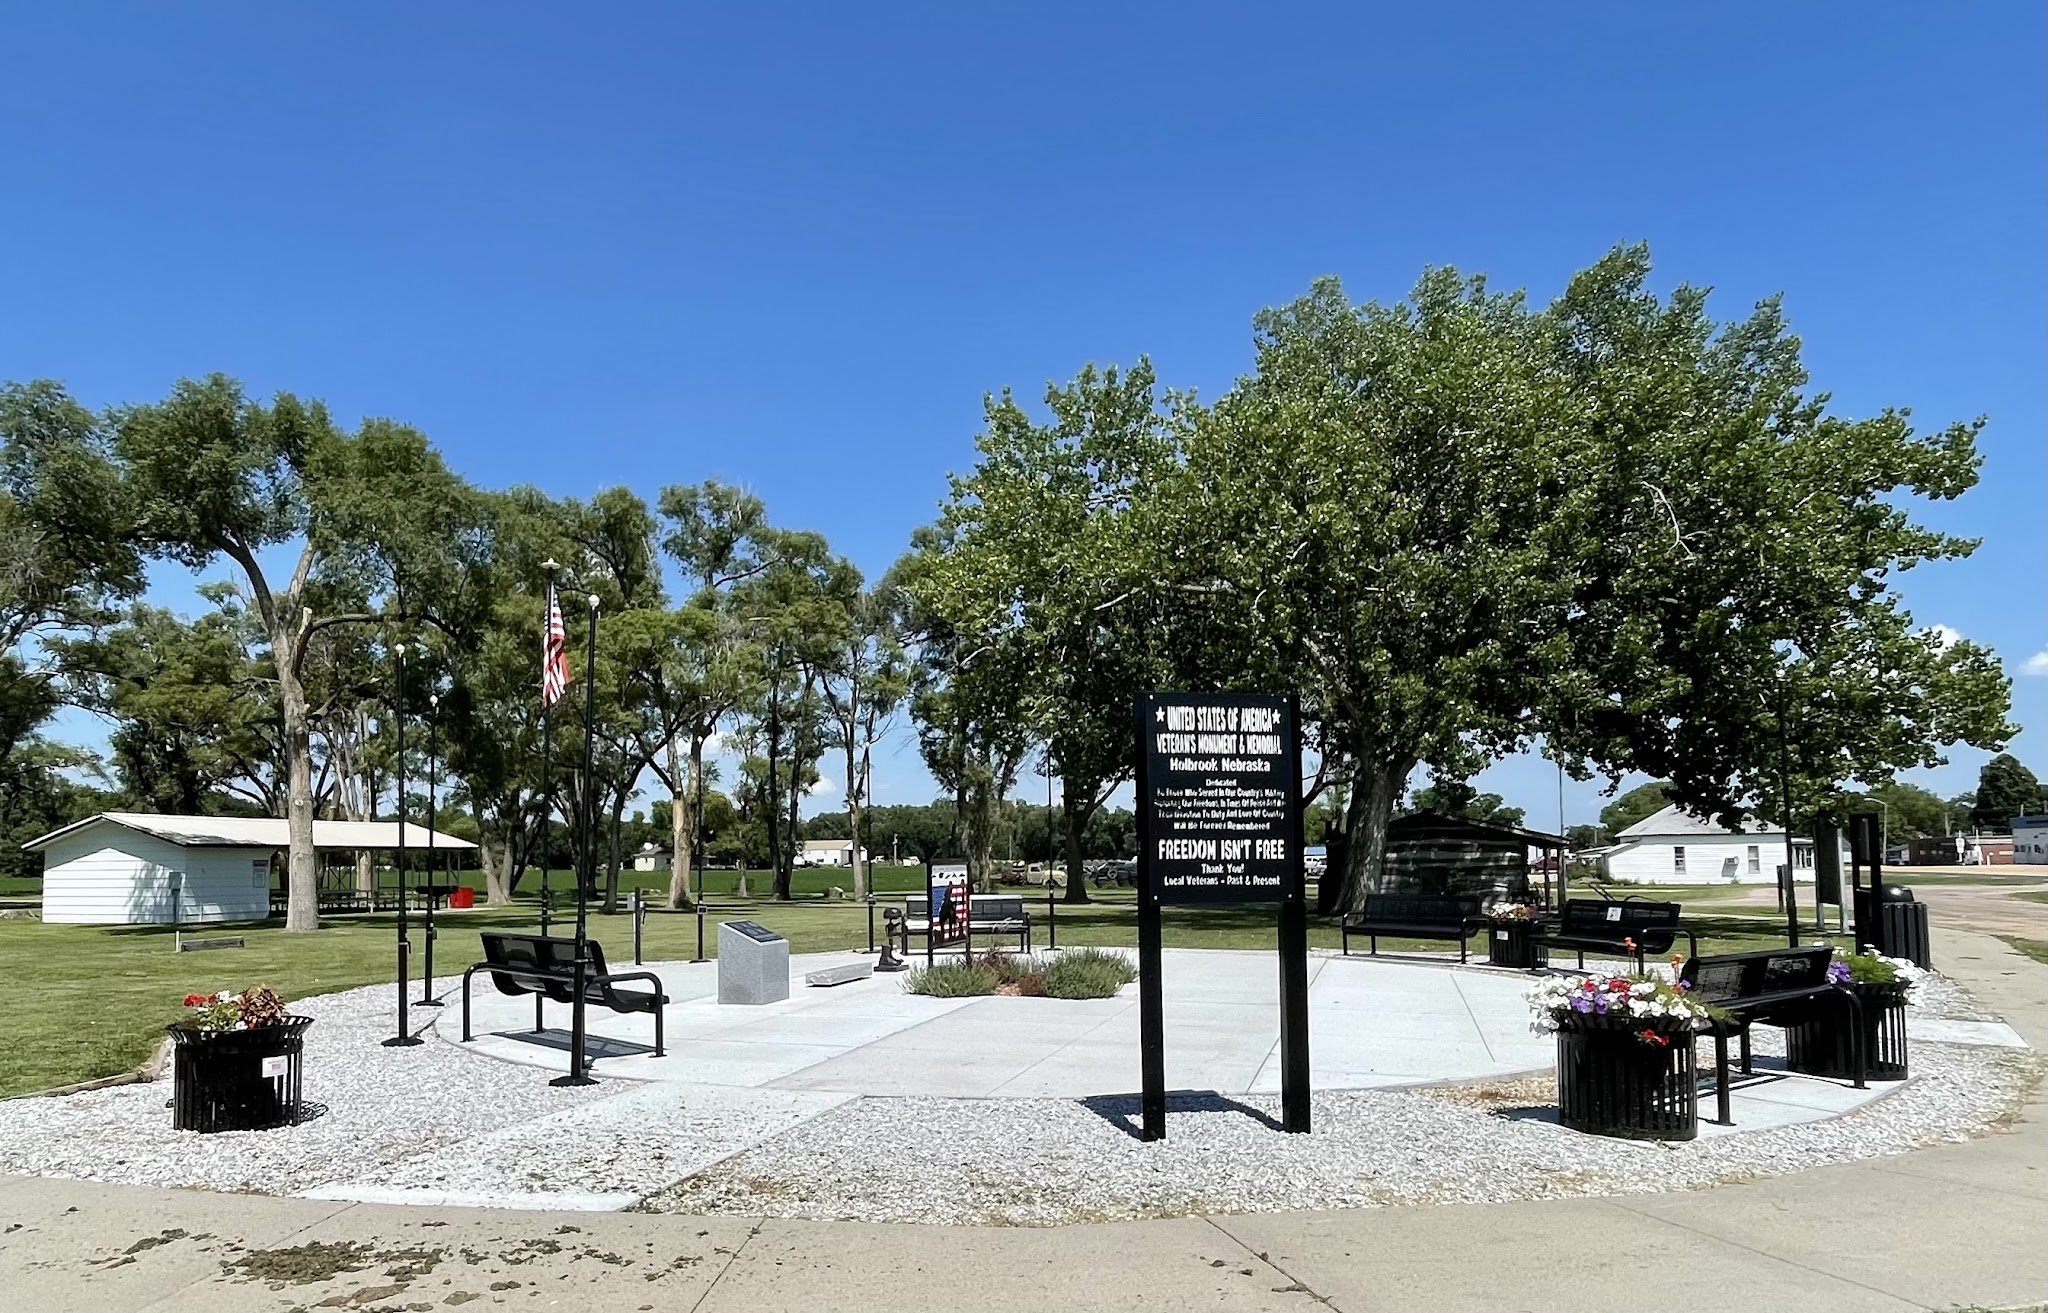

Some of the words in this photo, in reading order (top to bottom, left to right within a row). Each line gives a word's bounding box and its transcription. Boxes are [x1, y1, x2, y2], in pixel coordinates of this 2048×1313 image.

[1167, 706, 1195, 731] UNITED
[1197, 706, 1226, 731] STATES
[1227, 707, 1239, 731] OF
[1240, 708, 1273, 732] AMERICA
[1198, 734, 1237, 754] MONUMENT
[1239, 735, 1245, 754] &
[1247, 735, 1282, 755] MEMORIAL
[1169, 758, 1218, 771] Holbrook
[1221, 758, 1271, 772] Nebraska
[1205, 778, 1237, 786] Dedicated
[1184, 788, 1198, 796] Who
[1198, 787, 1218, 797] Served
[1225, 787, 1236, 797] Our
[1210, 809, 1225, 820] Duty
[1226, 809, 1238, 818] And
[1238, 809, 1252, 818] Love
[1253, 809, 1261, 818] Of
[1226, 821, 1271, 831] Remembered
[1158, 839, 1216, 860] FREEDOM
[1220, 839, 1251, 860] ISN'T
[1255, 839, 1285, 860] FREE
[1201, 863, 1224, 874] Thank
[1226, 863, 1244, 874] You!
[1164, 875, 1184, 886] Local
[1186, 875, 1219, 885] Veterans
[1226, 875, 1243, 886] Past
[1252, 875, 1280, 886] Present
